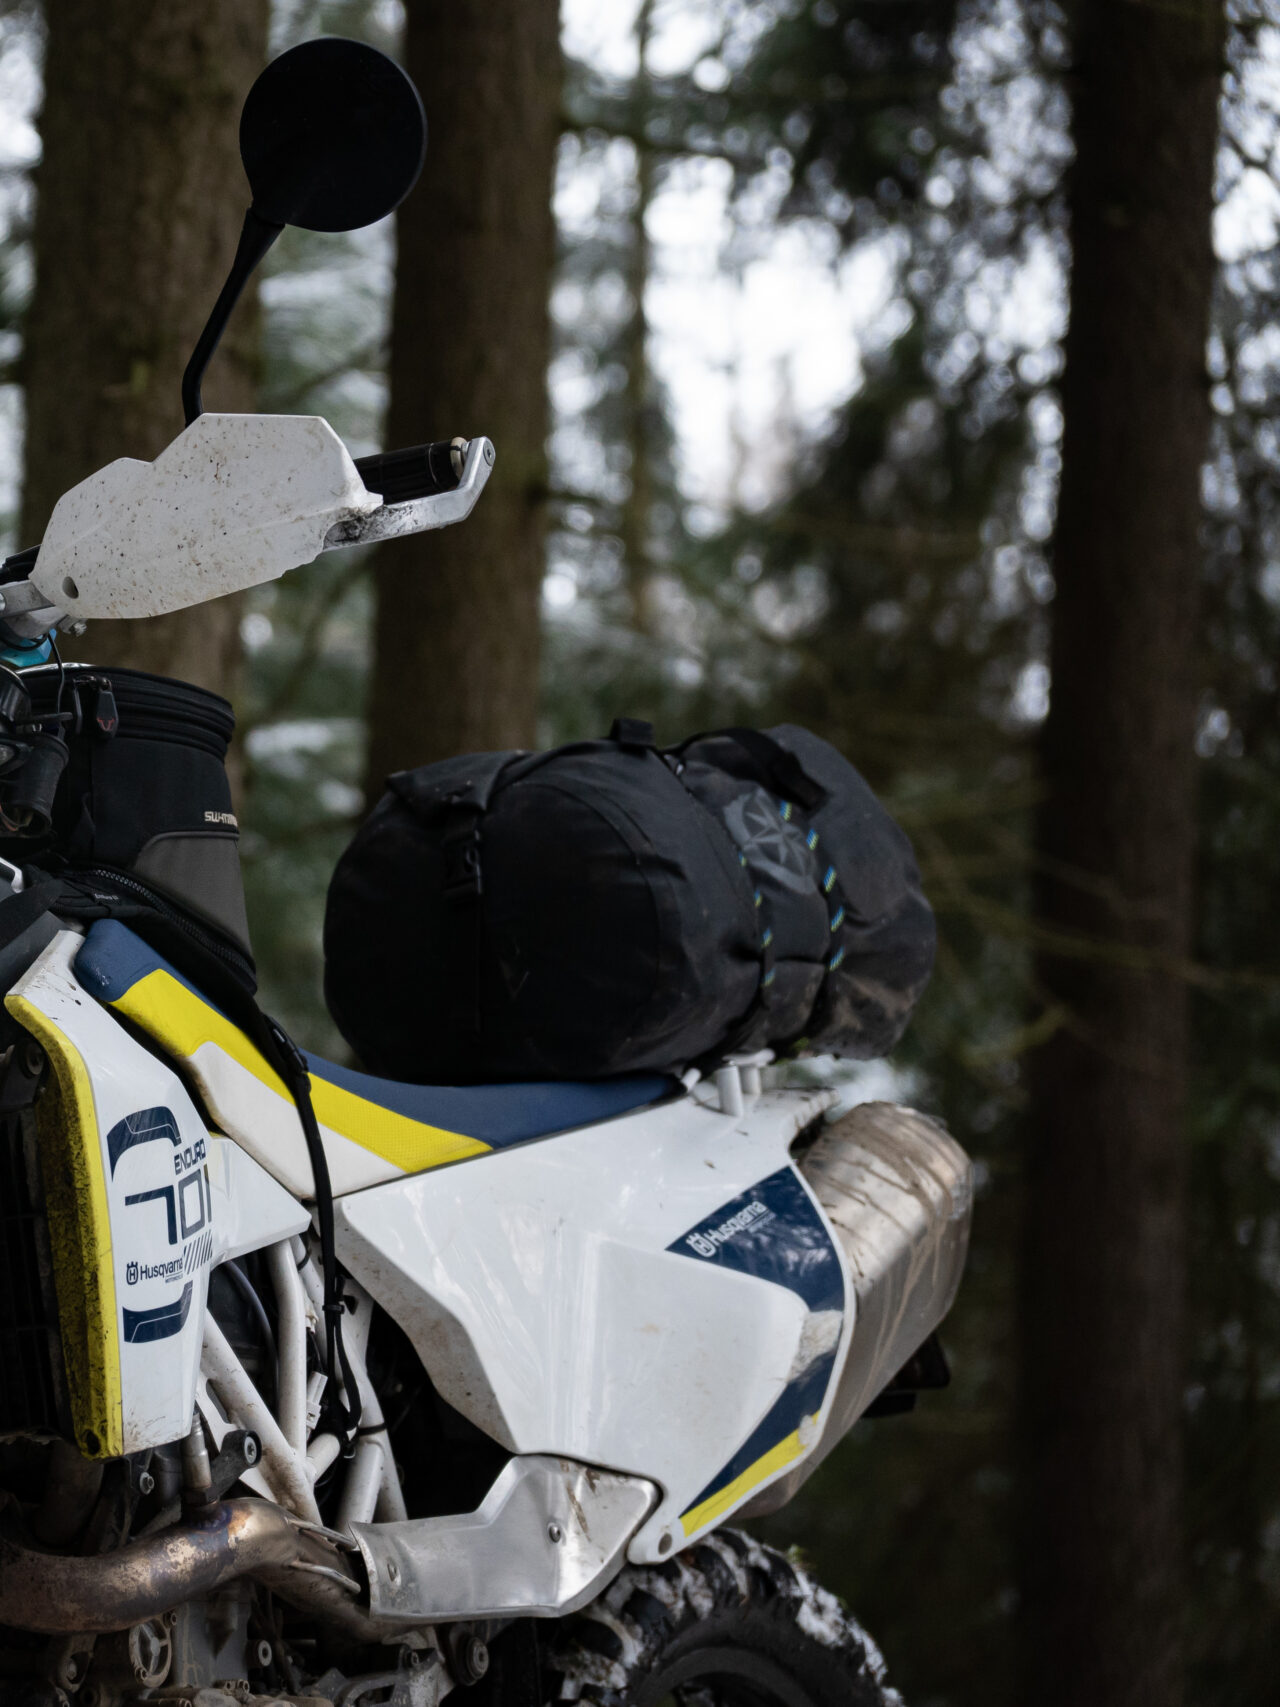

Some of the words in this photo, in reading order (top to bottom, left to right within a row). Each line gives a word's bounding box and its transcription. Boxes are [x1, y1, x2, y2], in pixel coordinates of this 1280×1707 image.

[174, 1138, 206, 1175] ENDURO
[125, 1164, 212, 1245] 701
[704, 1201, 768, 1246] Husqvarna
[140, 1258, 183, 1280] Husqvarna
